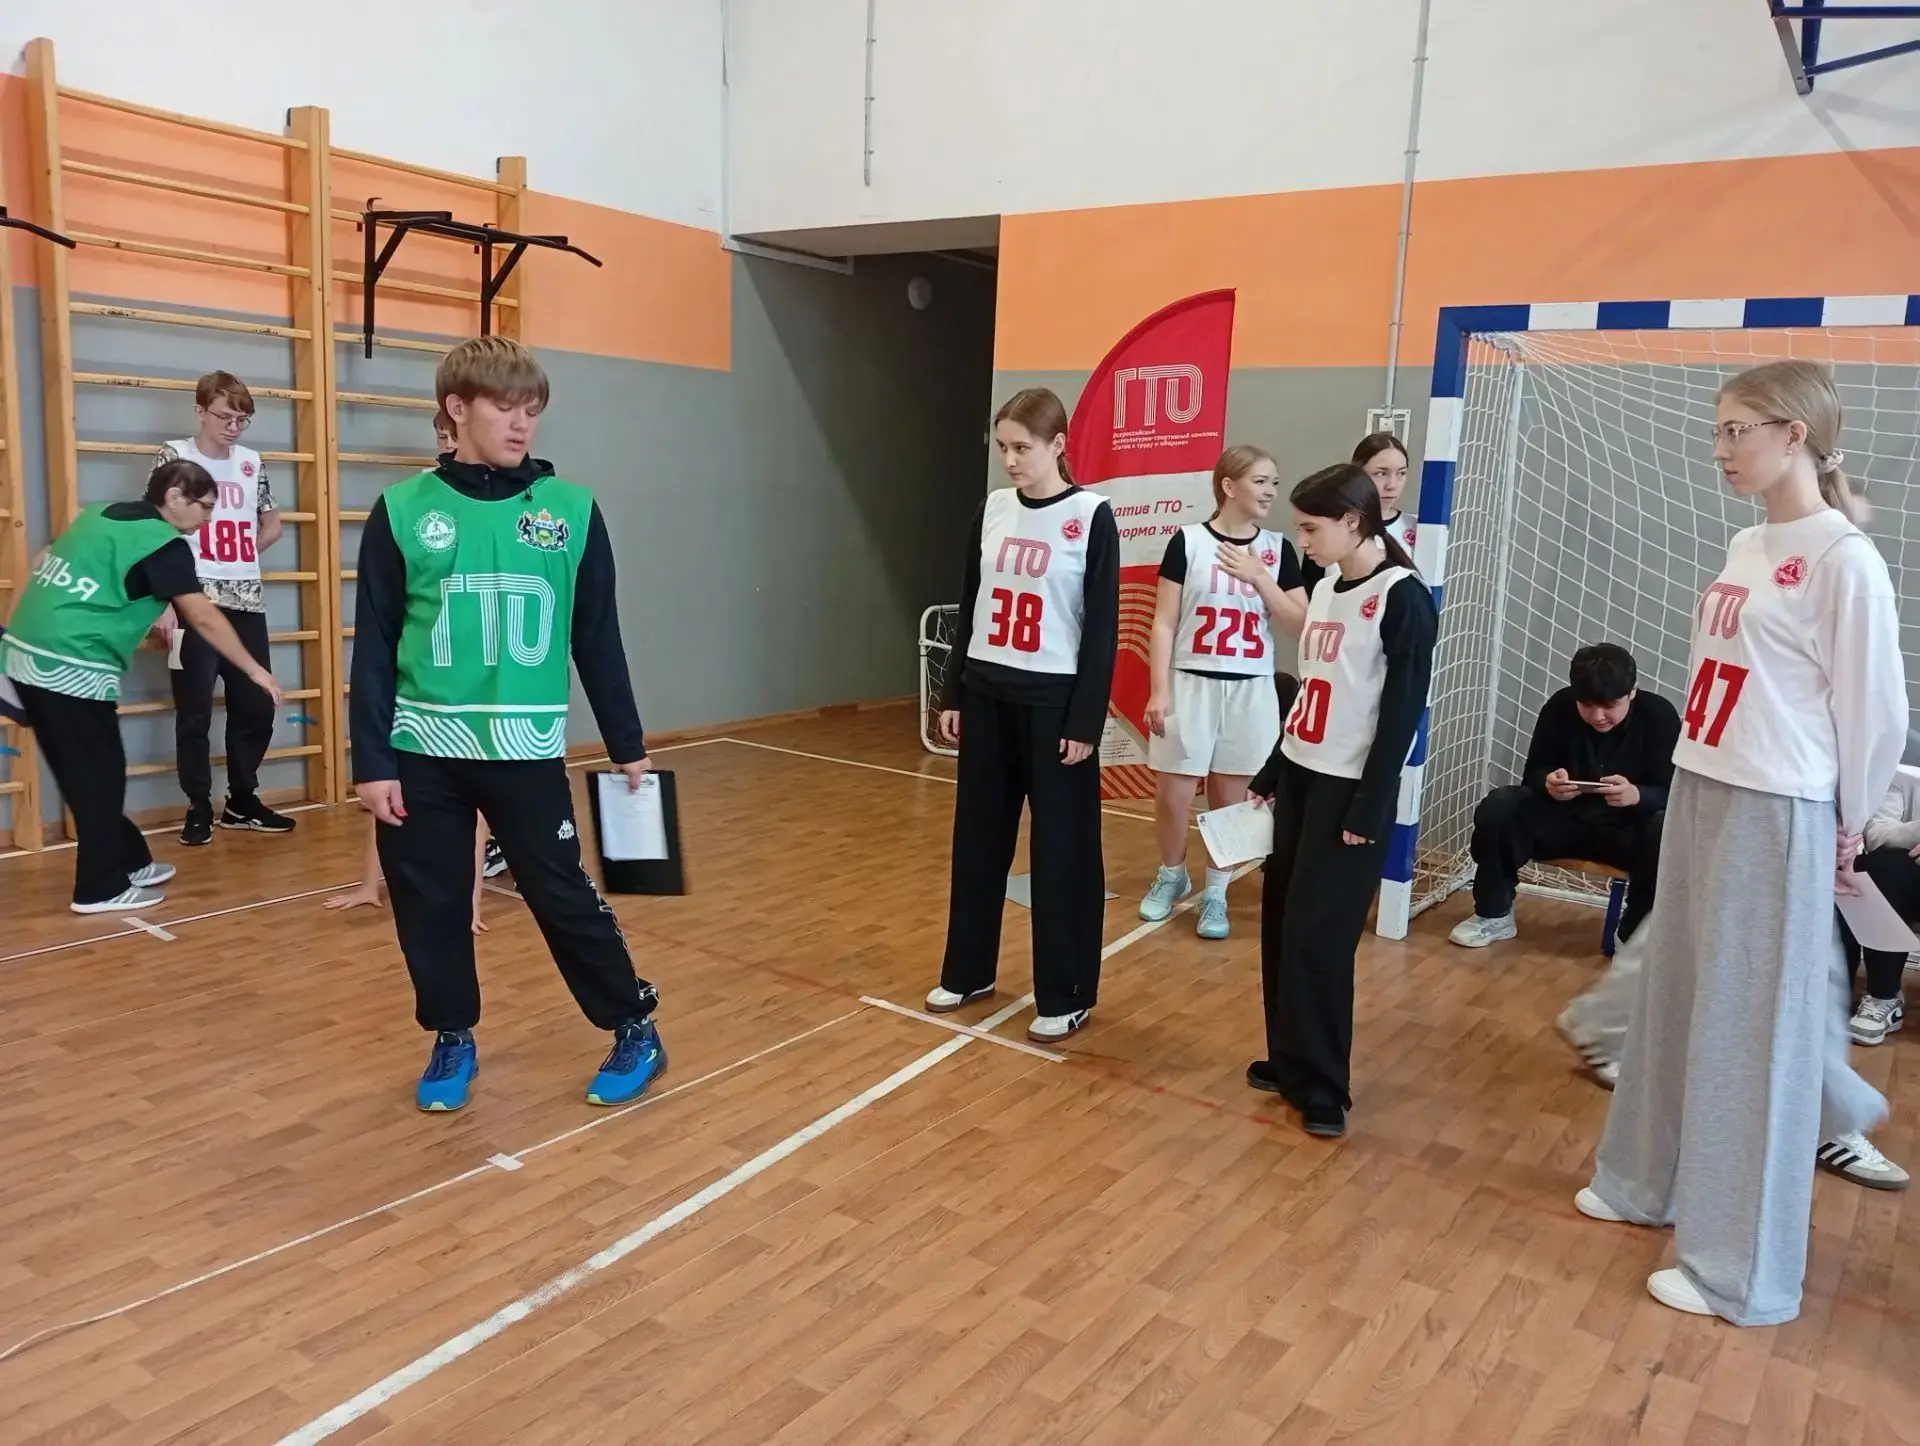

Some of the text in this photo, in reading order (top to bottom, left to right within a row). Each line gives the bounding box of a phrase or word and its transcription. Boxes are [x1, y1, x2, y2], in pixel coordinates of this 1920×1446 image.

[1113, 363, 1203, 429] ГТО
[215, 480, 245, 510] ТО
[1112, 505, 1150, 517] атив
[1154, 500, 1183, 514] ГТО
[199, 519, 256, 562] 186
[996, 536, 1051, 578] ГТО
[432, 573, 556, 667] ГТО
[988, 587, 1043, 653] 38
[1192, 606, 1265, 659] 225
[1698, 582, 1750, 639] ГТО
[1304, 620, 1346, 663] ГТО
[1684, 657, 1750, 747] 47
